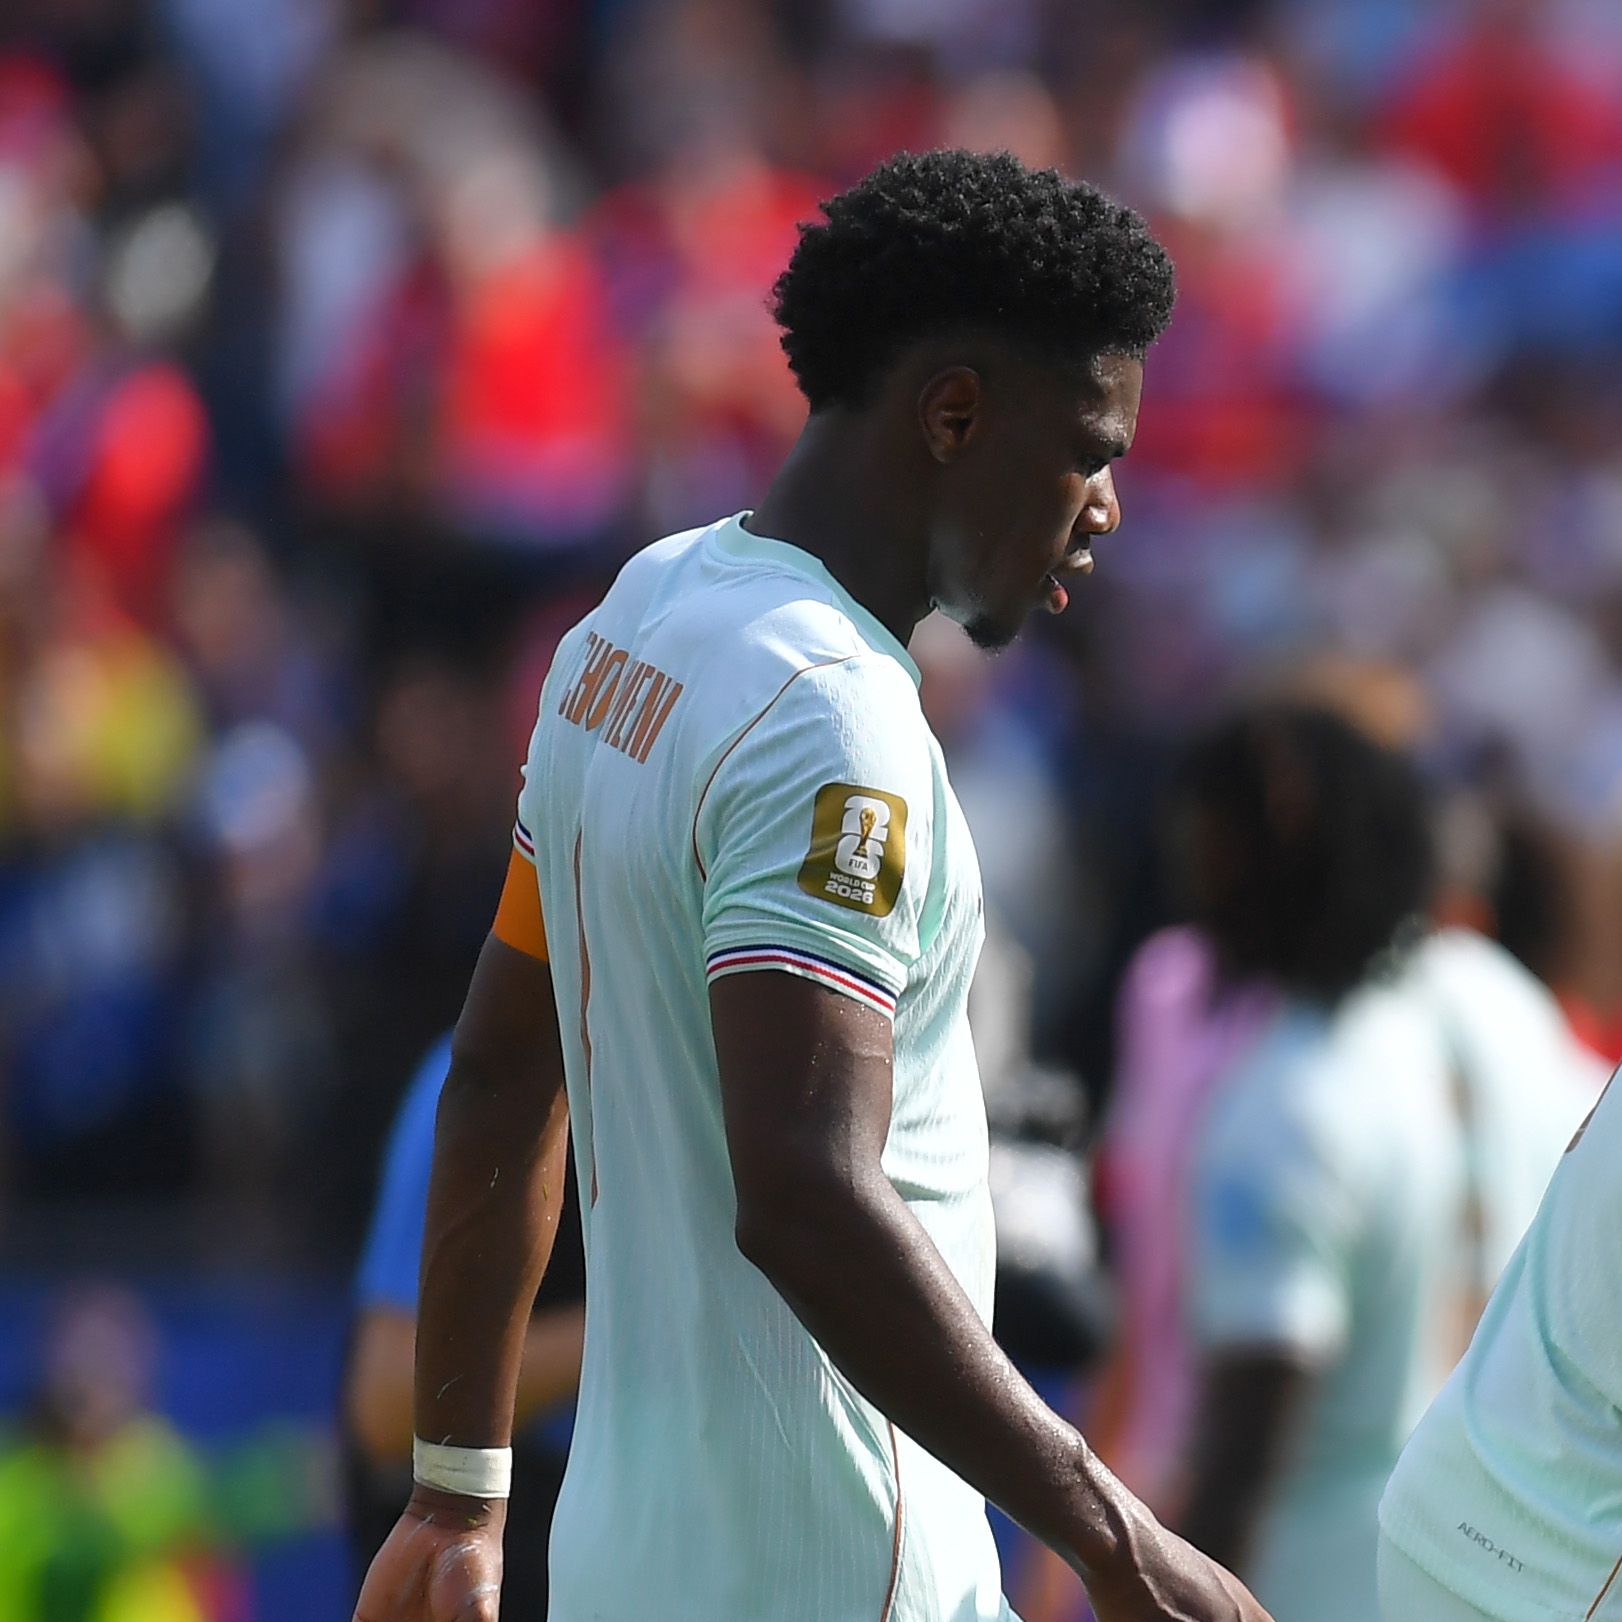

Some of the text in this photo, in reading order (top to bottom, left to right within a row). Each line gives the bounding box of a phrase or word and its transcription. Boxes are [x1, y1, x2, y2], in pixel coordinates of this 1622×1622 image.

[848, 858, 868, 872] FIFA
[829, 872, 861, 888] WORLD
[824, 880, 874, 905] 2026
[1457, 1521, 1526, 1573] AERO-FIT
